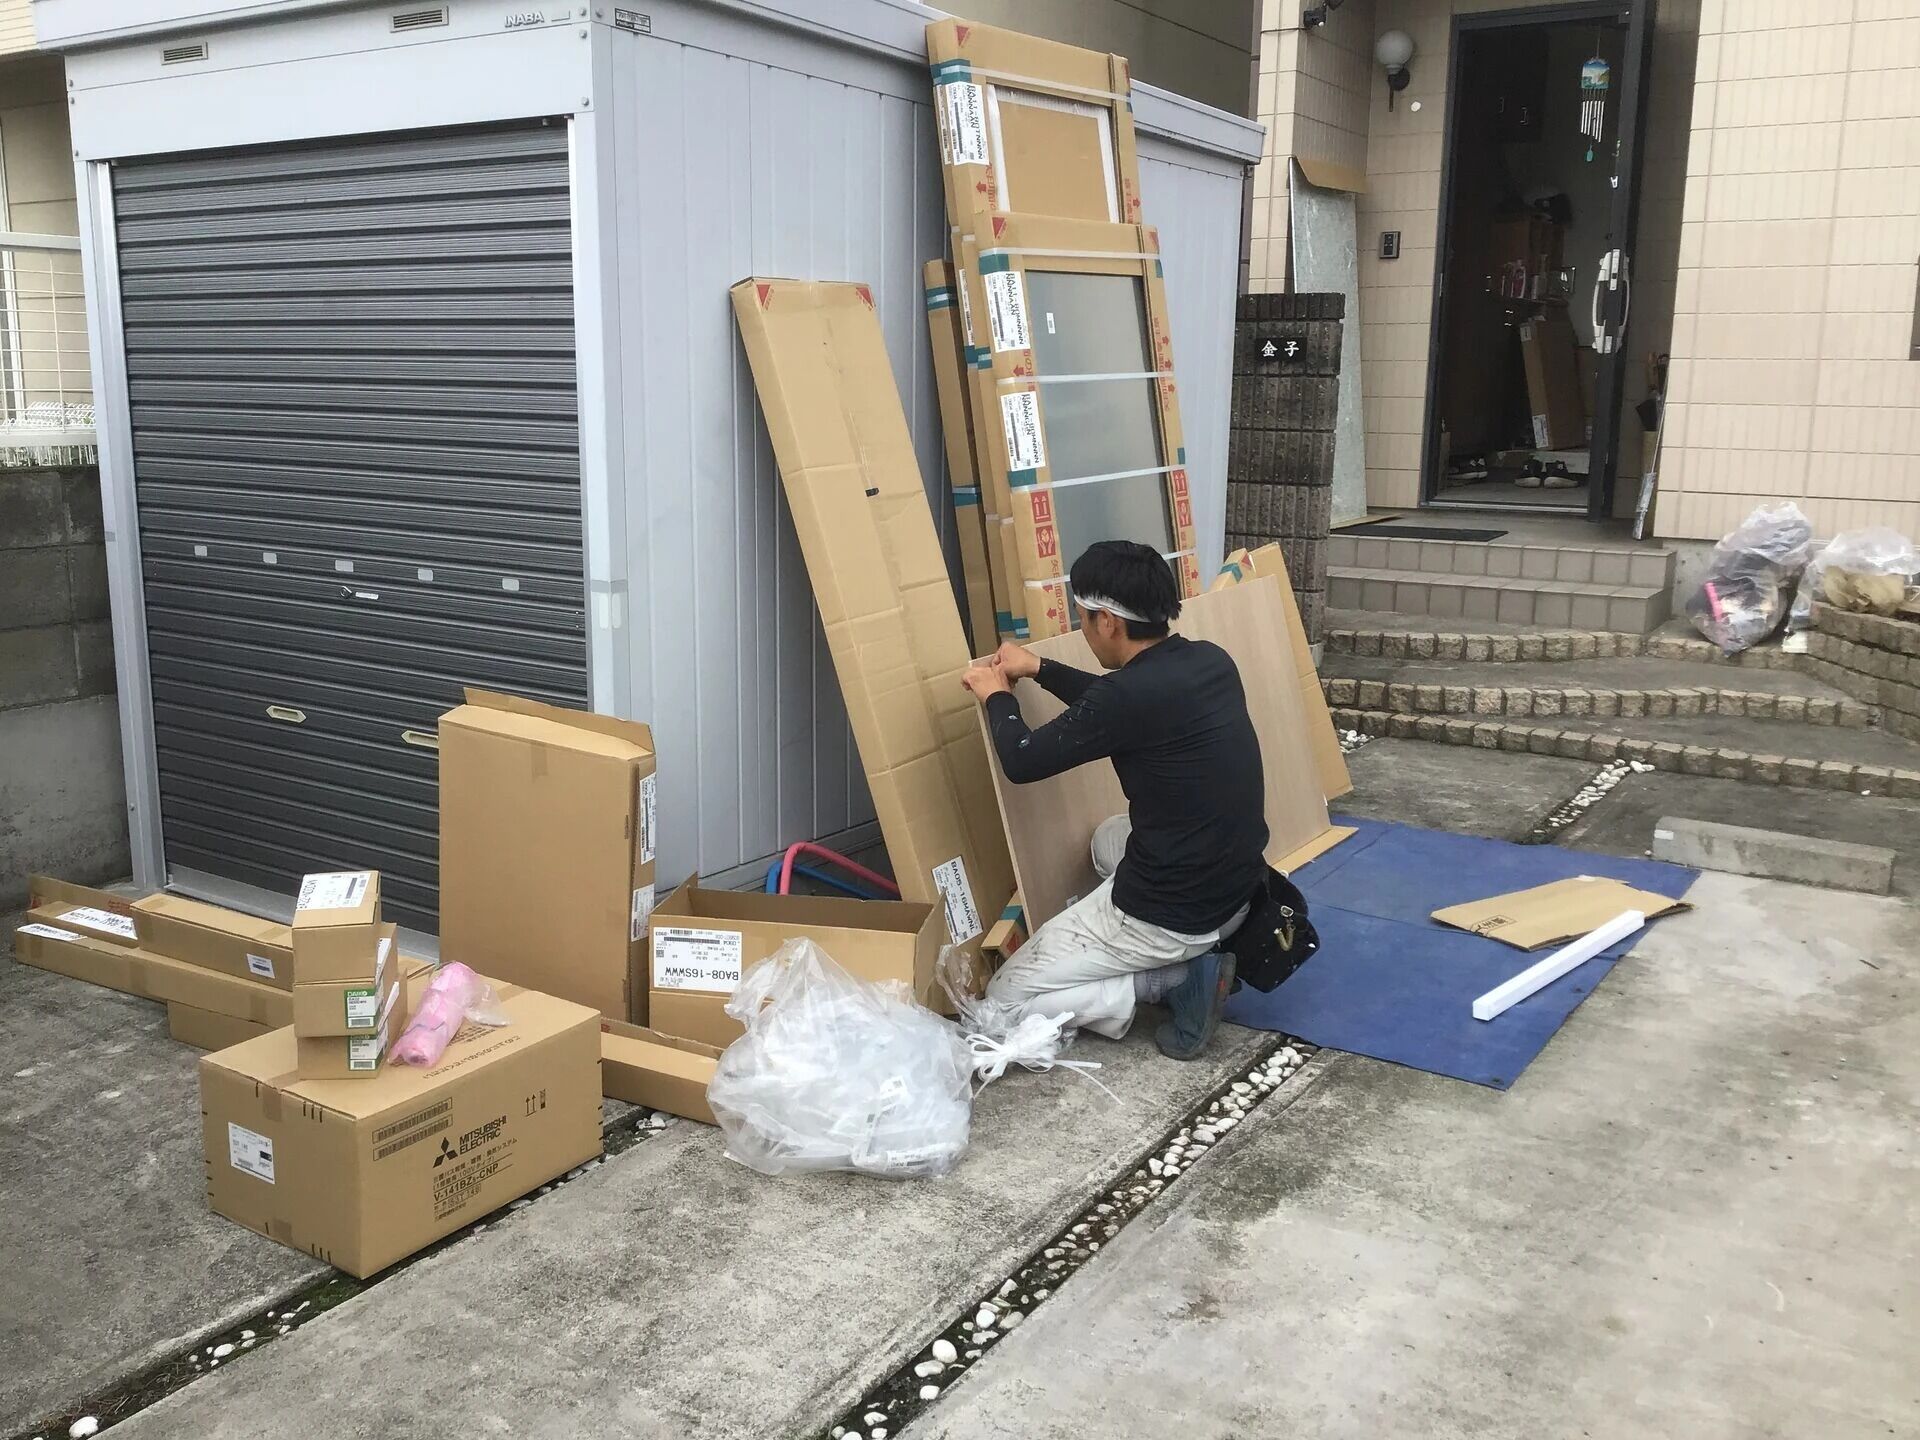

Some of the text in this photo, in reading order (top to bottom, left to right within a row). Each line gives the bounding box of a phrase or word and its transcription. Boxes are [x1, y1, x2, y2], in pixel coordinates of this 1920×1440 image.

[504, 11, 545, 28] INABA
[1261, 340, 1300, 357] 金子
[664, 967, 739, 982] BA08-16SWWW
[459, 1115, 507, 1145] MITSUBISHI
[459, 1128, 501, 1155] ELECTRIC
